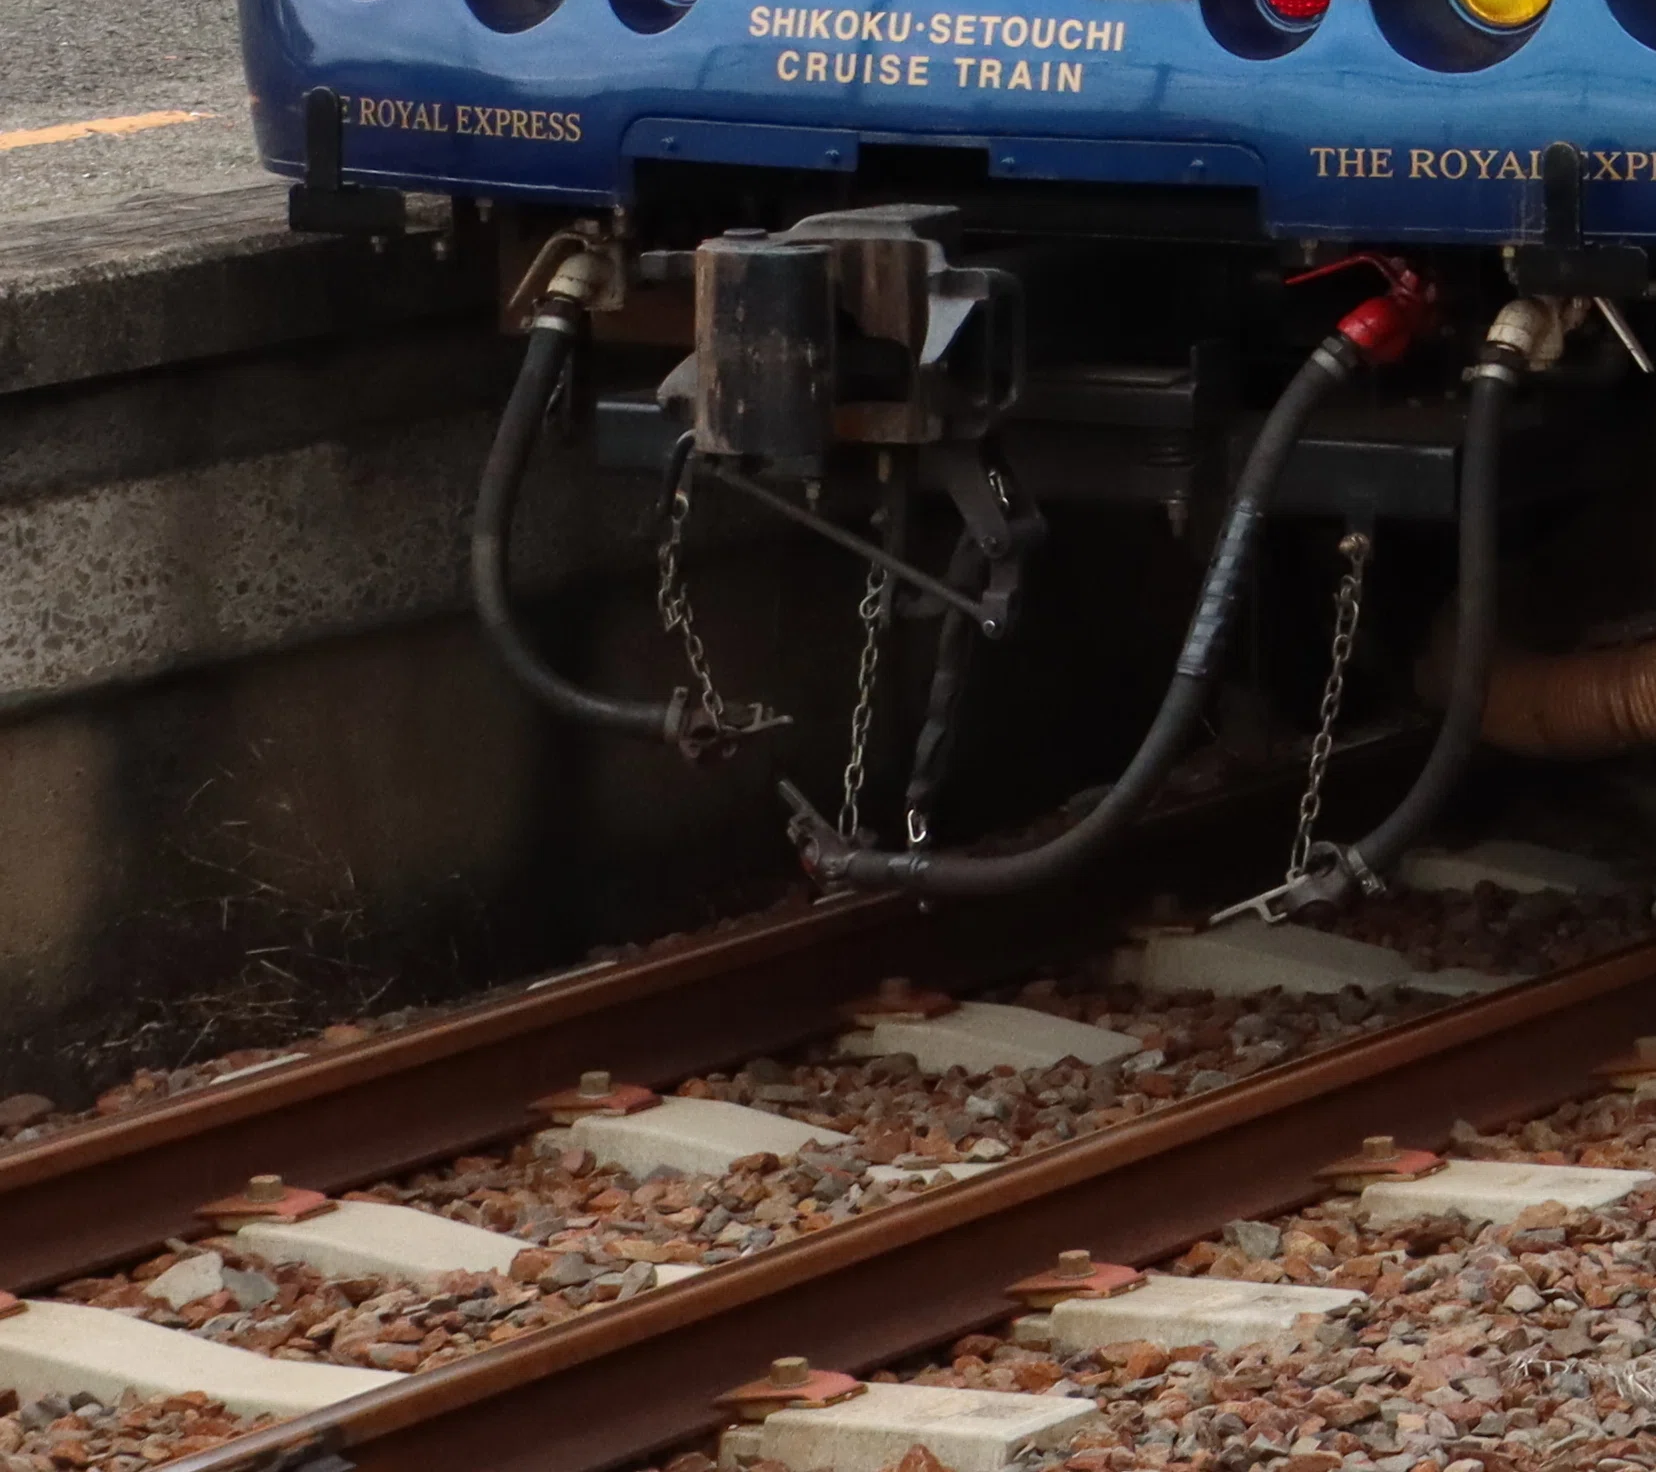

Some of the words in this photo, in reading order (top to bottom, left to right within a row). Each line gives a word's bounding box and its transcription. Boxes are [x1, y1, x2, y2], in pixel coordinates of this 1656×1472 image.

[776, 50, 931, 87] CRUISE
[954, 57, 1084, 93] TRAIN
[358, 97, 449, 133] ROYAL
[455, 106, 583, 143] EXPRESS
[1309, 147, 1395, 179] THE
